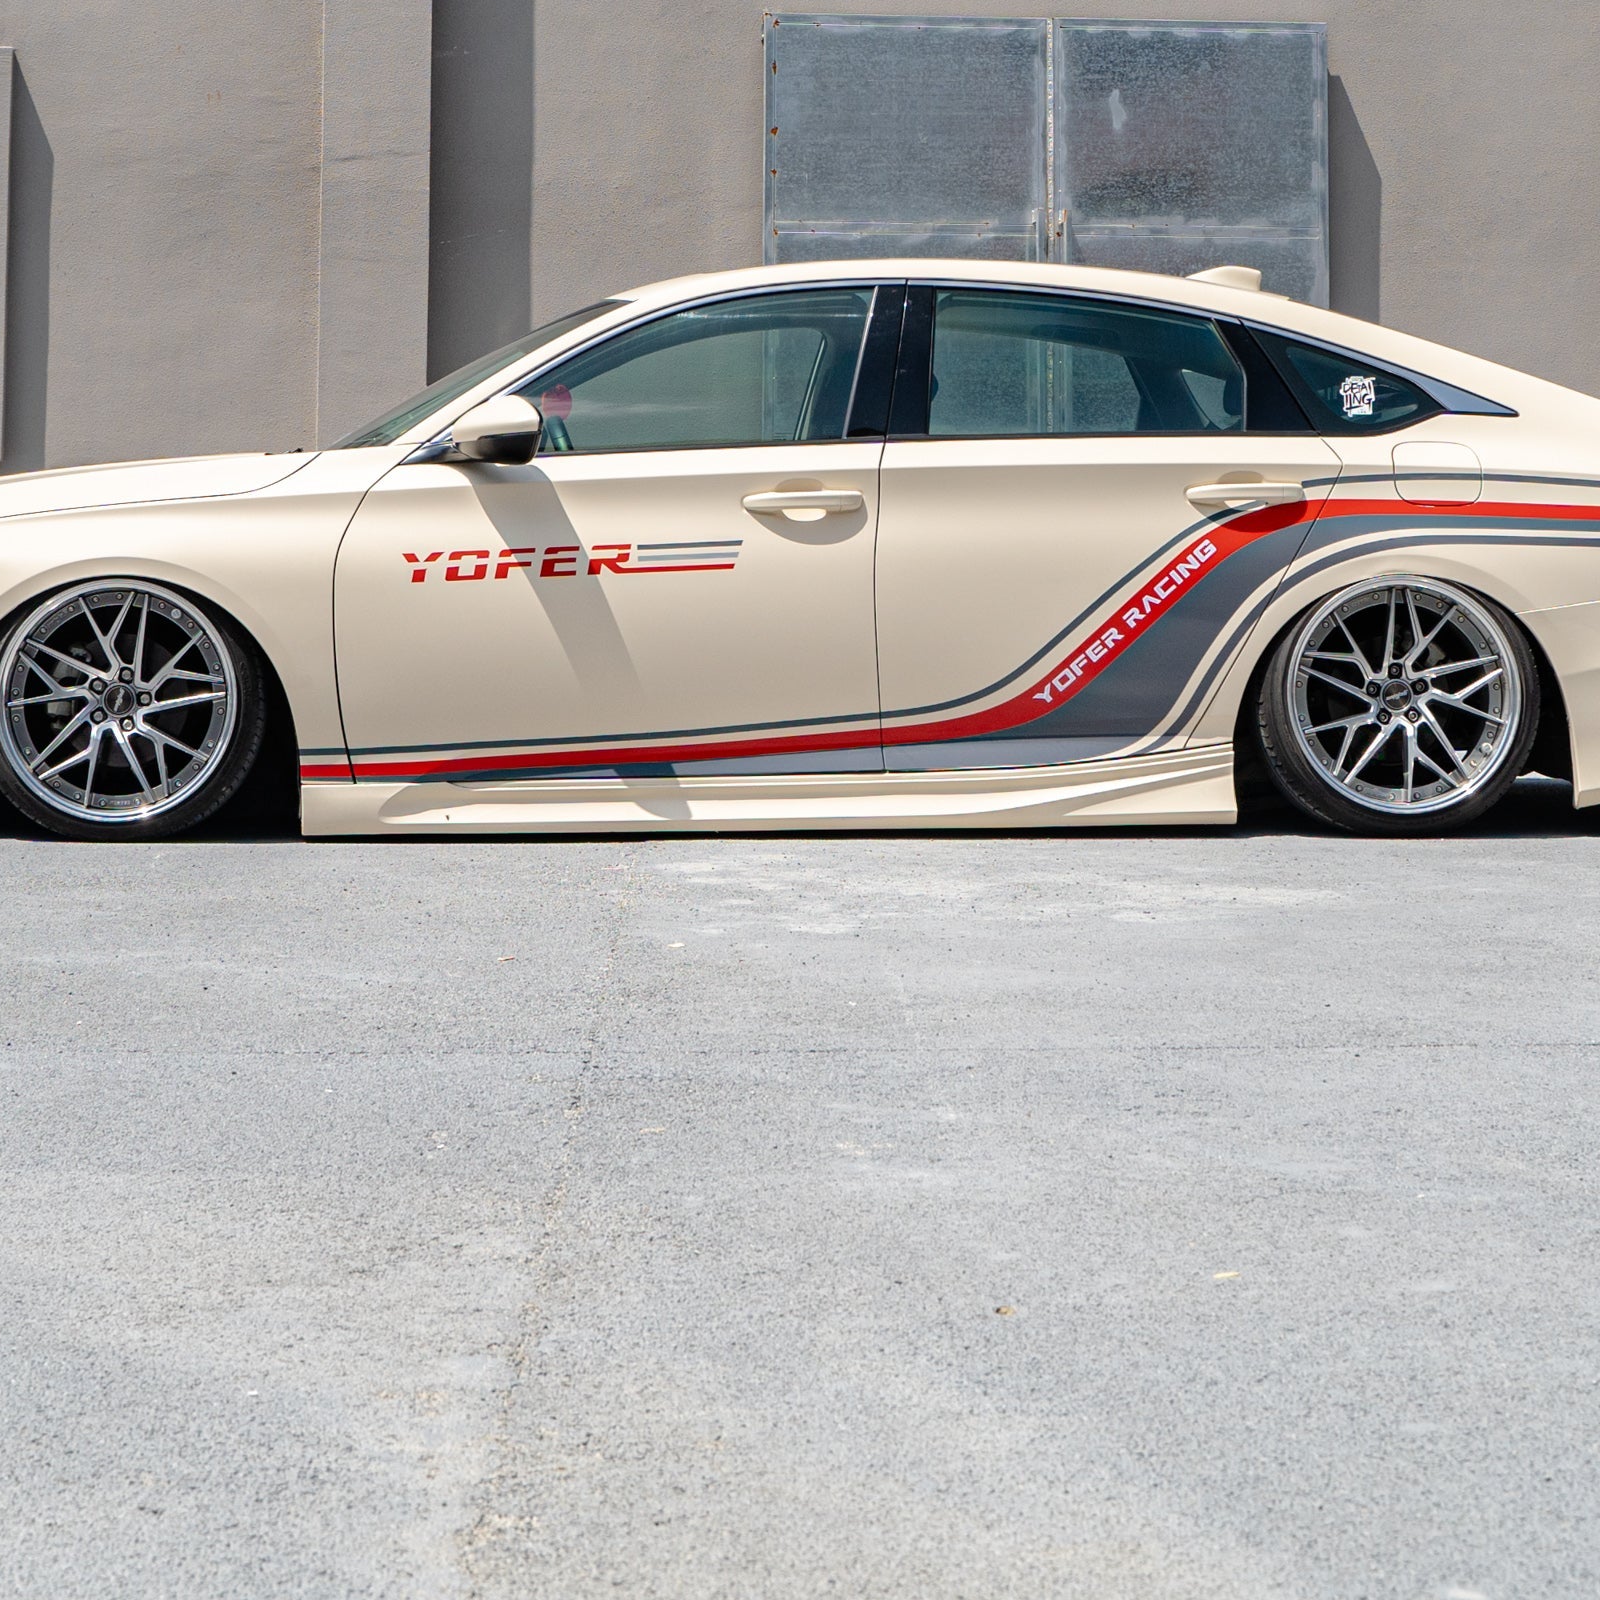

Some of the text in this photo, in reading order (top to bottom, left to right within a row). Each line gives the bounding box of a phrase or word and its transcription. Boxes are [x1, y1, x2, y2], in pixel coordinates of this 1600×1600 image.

[402, 543, 636, 583] YOFER
[1032, 538, 1217, 703] YOFER RACING
